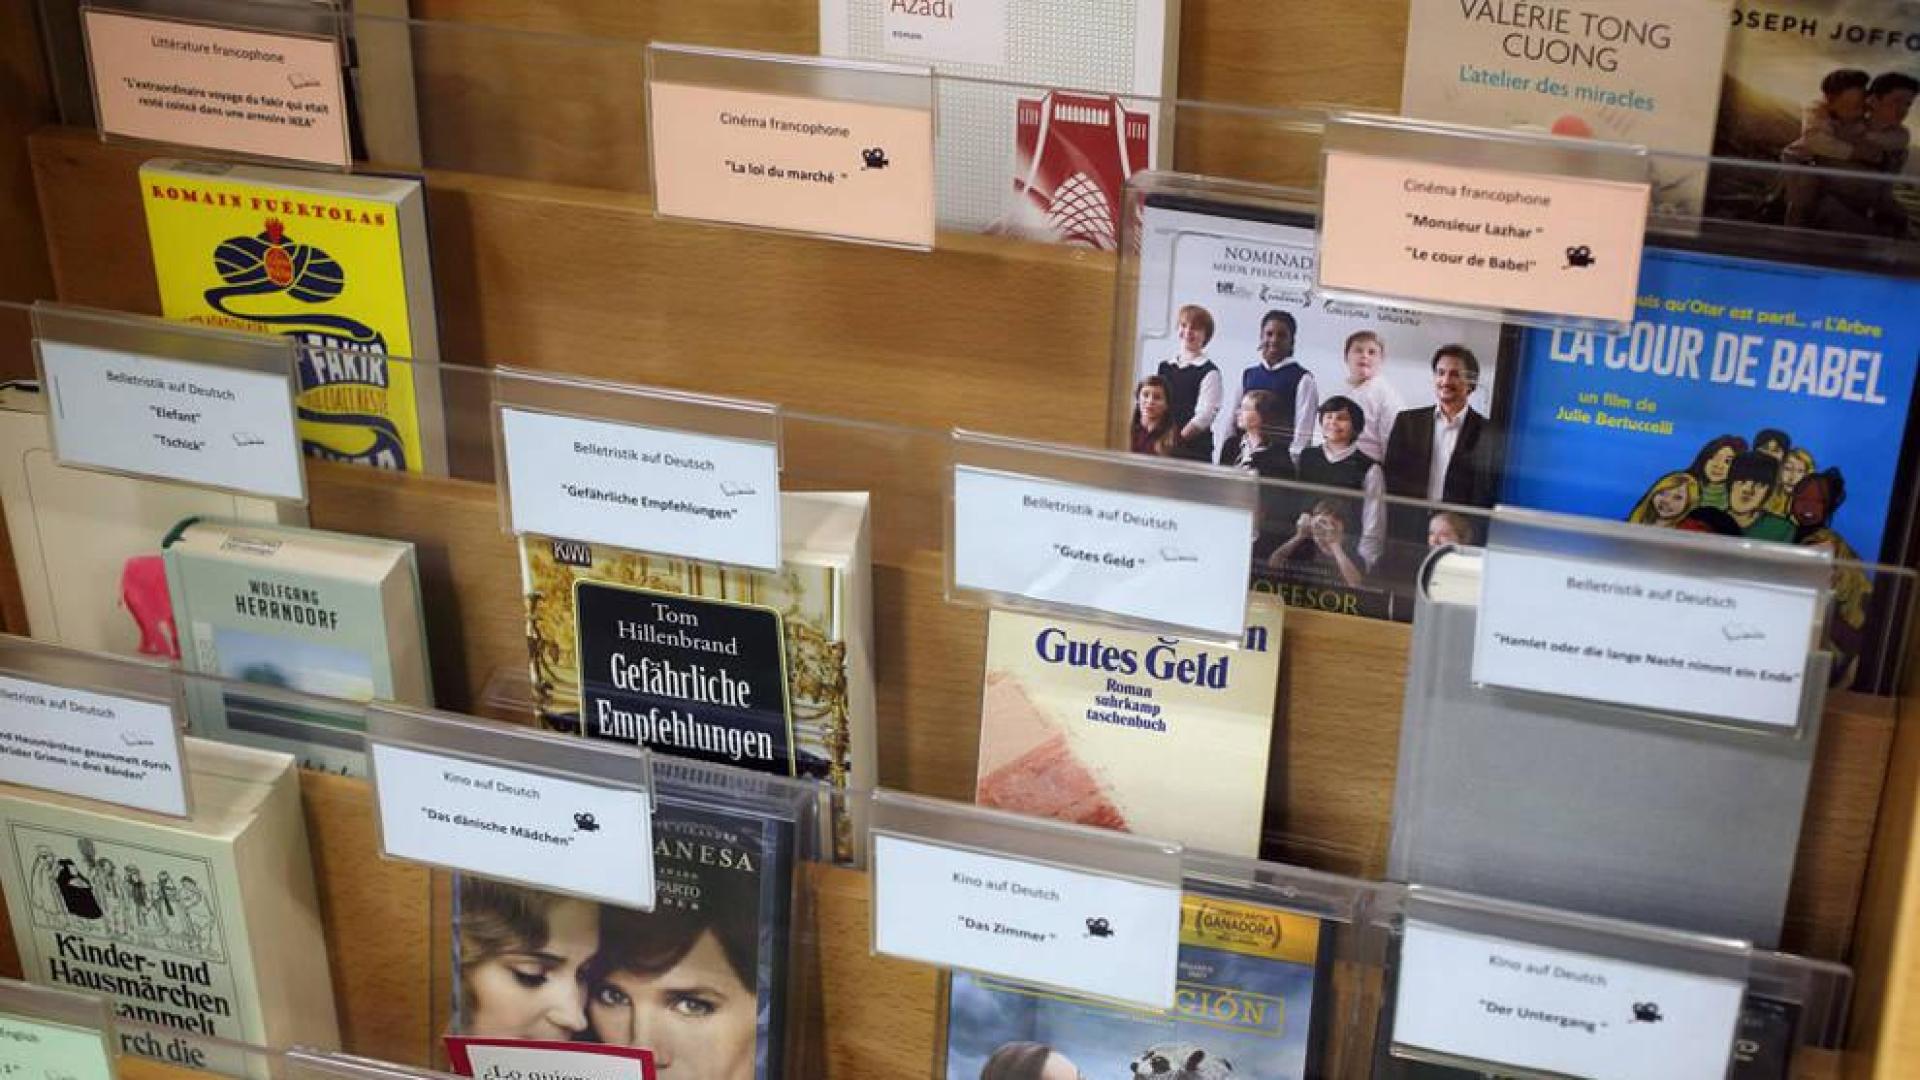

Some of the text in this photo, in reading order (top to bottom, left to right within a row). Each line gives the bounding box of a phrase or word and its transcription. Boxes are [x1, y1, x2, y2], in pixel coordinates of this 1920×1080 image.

[890, 0, 953, 20] Azadi
[1580, 12, 1672, 50] TONG
[213, 42, 286, 64] francophone
[1502, 32, 1619, 73] CUONG
[208, 89, 244, 105] voyage
[246, 93, 260, 105] du
[261, 95, 285, 108] fakir
[286, 98, 303, 113] qui
[1459, 63, 1656, 111] L'atelier des miracles
[199, 102, 224, 117] dans
[225, 106, 245, 119] une
[246, 110, 286, 125] armoire
[719, 111, 851, 139] Cinéma francophone
[724, 159, 746, 174] "La
[748, 162, 766, 177] loi
[767, 165, 785, 179] du
[787, 167, 836, 185] marché
[152, 184, 243, 208] ROMAIN
[1403, 178, 1551, 206] Cinéma francophone
[1405, 212, 1482, 235] "Monsieur
[1484, 219, 1533, 239] Lazhar
[1405, 245, 1537, 273] "Le cour de Babel"
[1547, 319, 1887, 405] LA COUR DE BABEL
[168, 380, 187, 394] auf
[188, 382, 236, 402] Deutsch
[1578, 388, 1657, 414] un film de
[149, 404, 202, 424] "Elefant"
[1555, 405, 1592, 425] Julie
[573, 441, 715, 472] Belletristik auf Deutsch
[561, 483, 738, 521] "Gefährliche Empfehlungen"
[1022, 494, 1178, 532] Belletristik auf Deutsch
[1053, 543, 1101, 564] "Gutes
[1103, 551, 1136, 569] Geld
[248, 579, 320, 606] WOLFGANG
[1566, 575, 1737, 609] Belletristik auf Deutsch
[234, 594, 339, 631] HERRNDORF
[650, 601, 699, 627] Tom
[617, 619, 739, 656] Hillenbrand
[1035, 626, 1230, 690] Gutes Geld
[1492, 631, 1801, 684] "Hamlet oder die lange Nacht nimmt ein Ende"
[610, 651, 752, 710] Gefährliche
[1106, 677, 1153, 699] Roman
[1094, 693, 1161, 717] suhrkamp
[595, 698, 775, 762] Empfehlungen
[1085, 708, 1167, 733] taschenbuch
[33, 751, 67, 765] Grimm
[69, 759, 81, 768] in
[82, 760, 101, 773] drei
[141, 759, 172, 773] durch
[442, 771, 541, 801] Kino auf Deutch
[421, 806, 575, 847] "Das dänische Mädchen"
[952, 871, 1061, 902] Kino auf Deutch
[958, 915, 990, 933] "Das
[992, 921, 1048, 943] Zimmer
[1203, 913, 1273, 934] GANADORA
[53, 931, 213, 987] Kinder- und
[1488, 954, 1609, 988] Kino auf Deutch
[48, 957, 232, 1017] Hausmärchen
[1478, 998, 1515, 1017] "Der
[1516, 1005, 1598, 1034] Untergang
[166, 1038, 207, 1068] die
